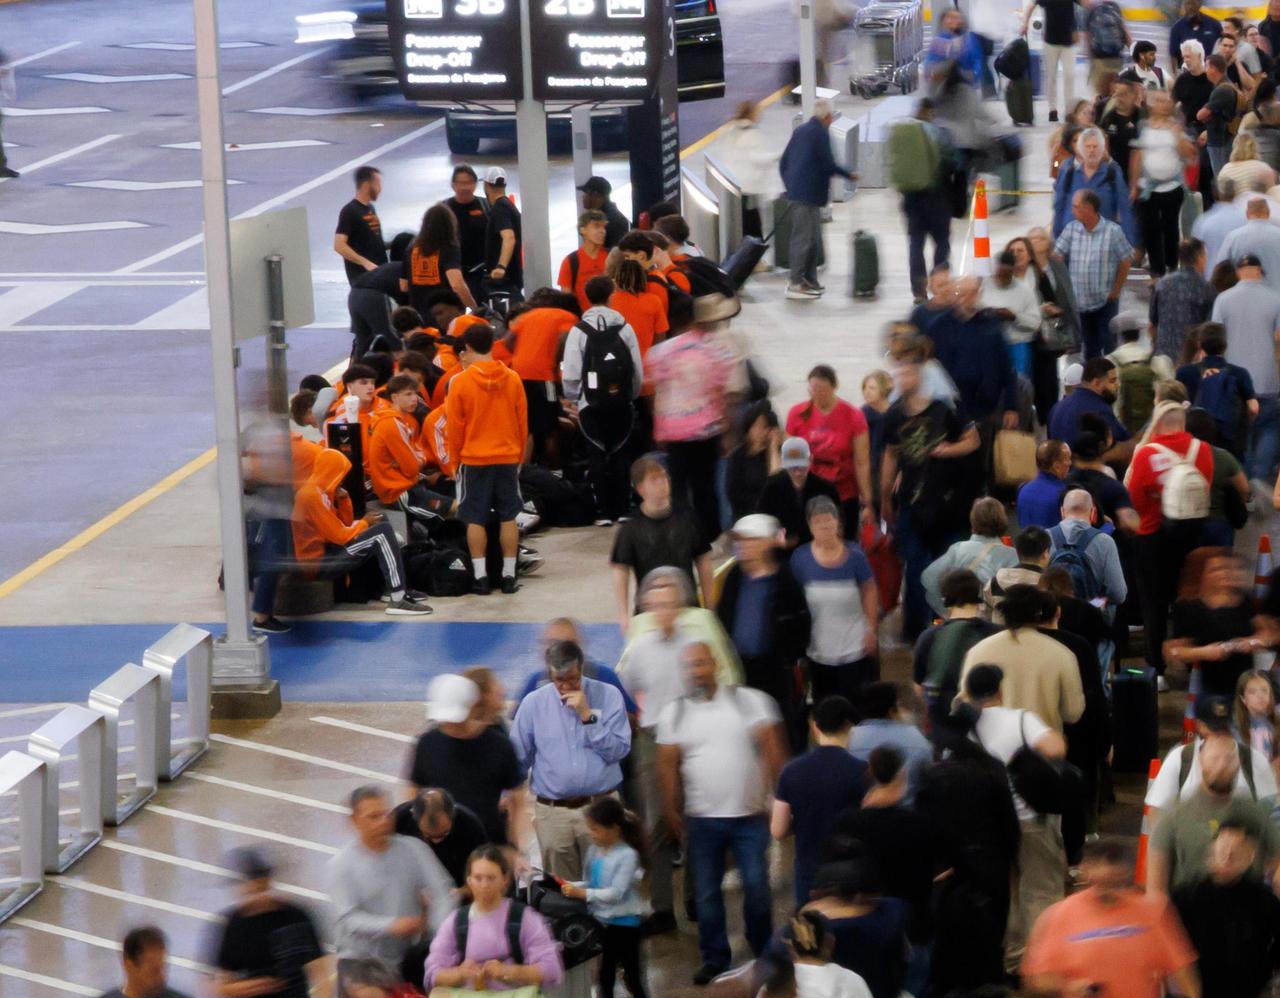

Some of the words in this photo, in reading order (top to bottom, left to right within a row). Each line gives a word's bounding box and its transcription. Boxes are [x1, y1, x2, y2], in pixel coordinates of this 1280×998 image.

[405, 33, 482, 51] Passenger
[568, 32, 646, 51] Passenger
[406, 52, 472, 70] Drop-Off
[580, 51, 646, 69] Drop-Off
